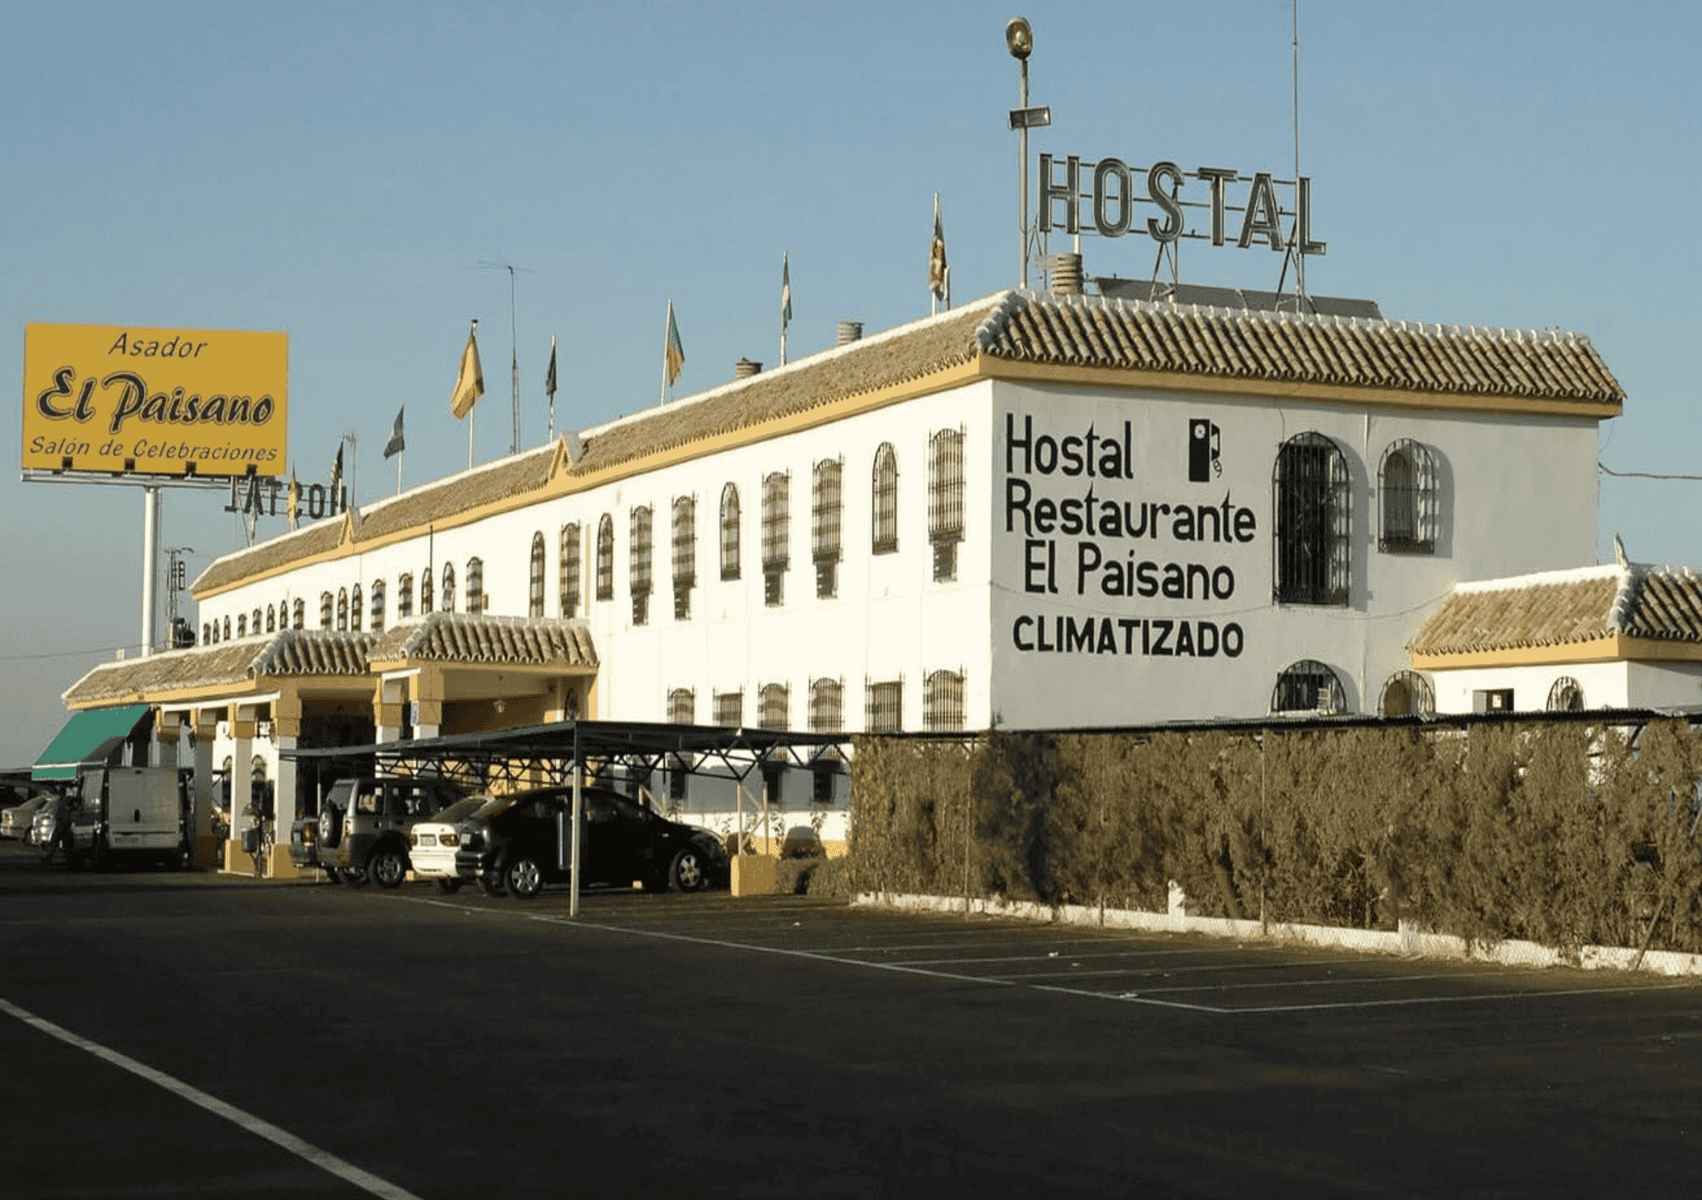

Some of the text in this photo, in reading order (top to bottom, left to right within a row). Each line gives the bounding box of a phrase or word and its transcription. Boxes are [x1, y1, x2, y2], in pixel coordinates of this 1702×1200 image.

[1039, 153, 1326, 255] HOSTAL
[108, 332, 208, 358] Asador
[37, 367, 275, 434] El Paisano
[30, 436, 278, 461] Salón de Celebraciones
[1006, 412, 1133, 479] Hostal
[1006, 477, 1257, 543] Restaurante
[1025, 539, 1058, 594] El
[1013, 615, 1244, 658] CLIMATIZADO
